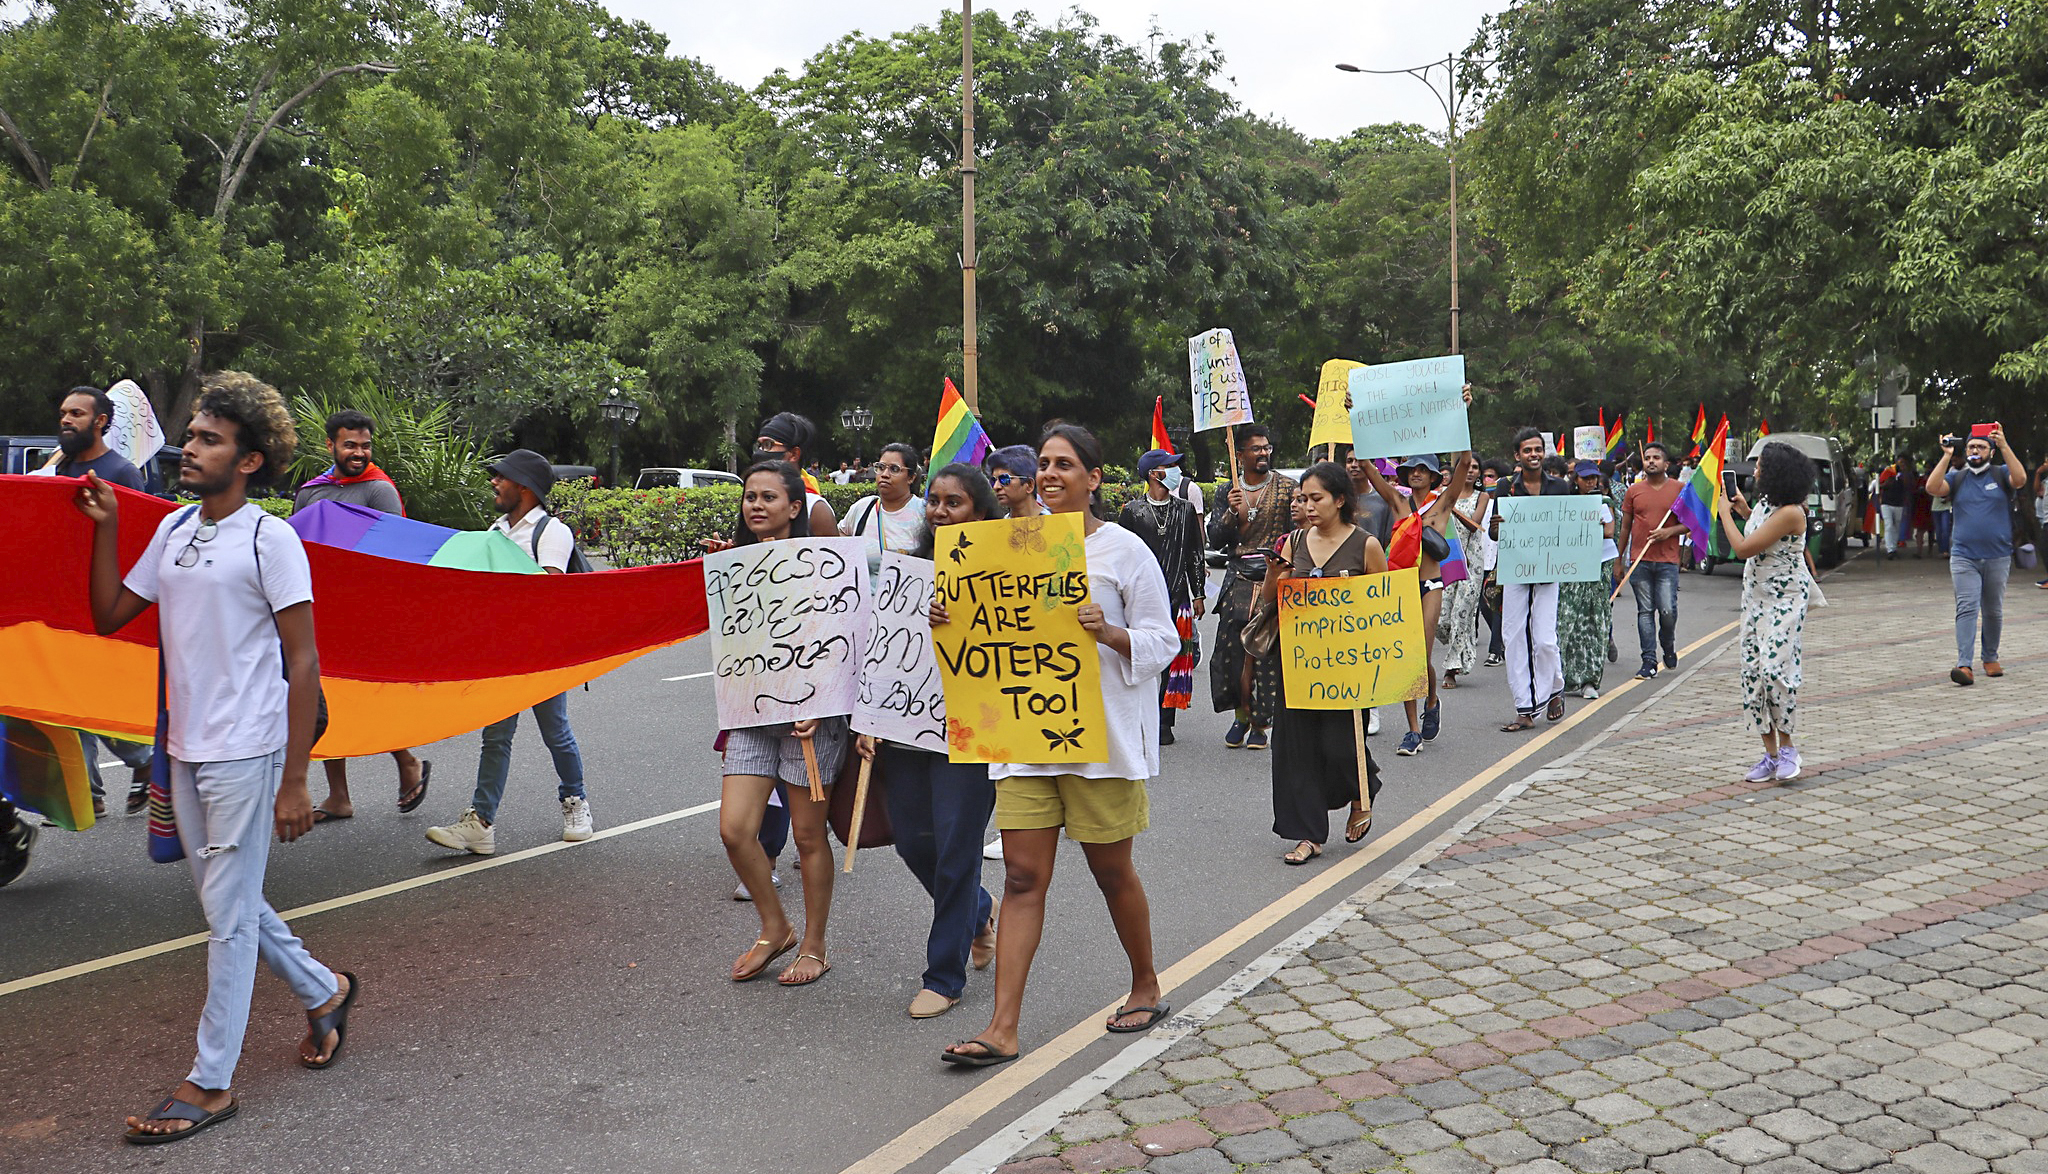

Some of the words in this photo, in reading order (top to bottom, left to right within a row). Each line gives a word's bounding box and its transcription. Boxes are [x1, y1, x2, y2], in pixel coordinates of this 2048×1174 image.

[1209, 331, 1223, 348] of
[1203, 372, 1213, 392] of
[1406, 361, 1450, 380] YOU'RE
[1203, 390, 1249, 421] FREE
[1367, 389, 1389, 404] THE
[1401, 381, 1438, 397] JOKE!
[1357, 403, 1415, 427] RELEASE
[1420, 397, 1465, 415] NATASHA
[1393, 426, 1427, 443] NOW!
[1508, 503, 1526, 524] You
[1531, 509, 1553, 523] won
[1558, 501, 1577, 522] the
[1580, 509, 1600, 522] war
[1498, 529, 1516, 550] But
[1519, 536, 1534, 548] we
[1538, 525, 1561, 555] paid
[1567, 523, 1593, 548] with
[1514, 563, 1538, 578] our
[1546, 552, 1578, 576] lives
[935, 570, 1088, 605] BUTTERFLIES
[1280, 581, 1354, 609] Release
[1366, 575, 1391, 598] all
[970, 602, 1035, 636] ARE
[1294, 596, 1405, 638] imprisoned
[936, 637, 1081, 682] VOTERS
[1293, 640, 1404, 670] Protestors
